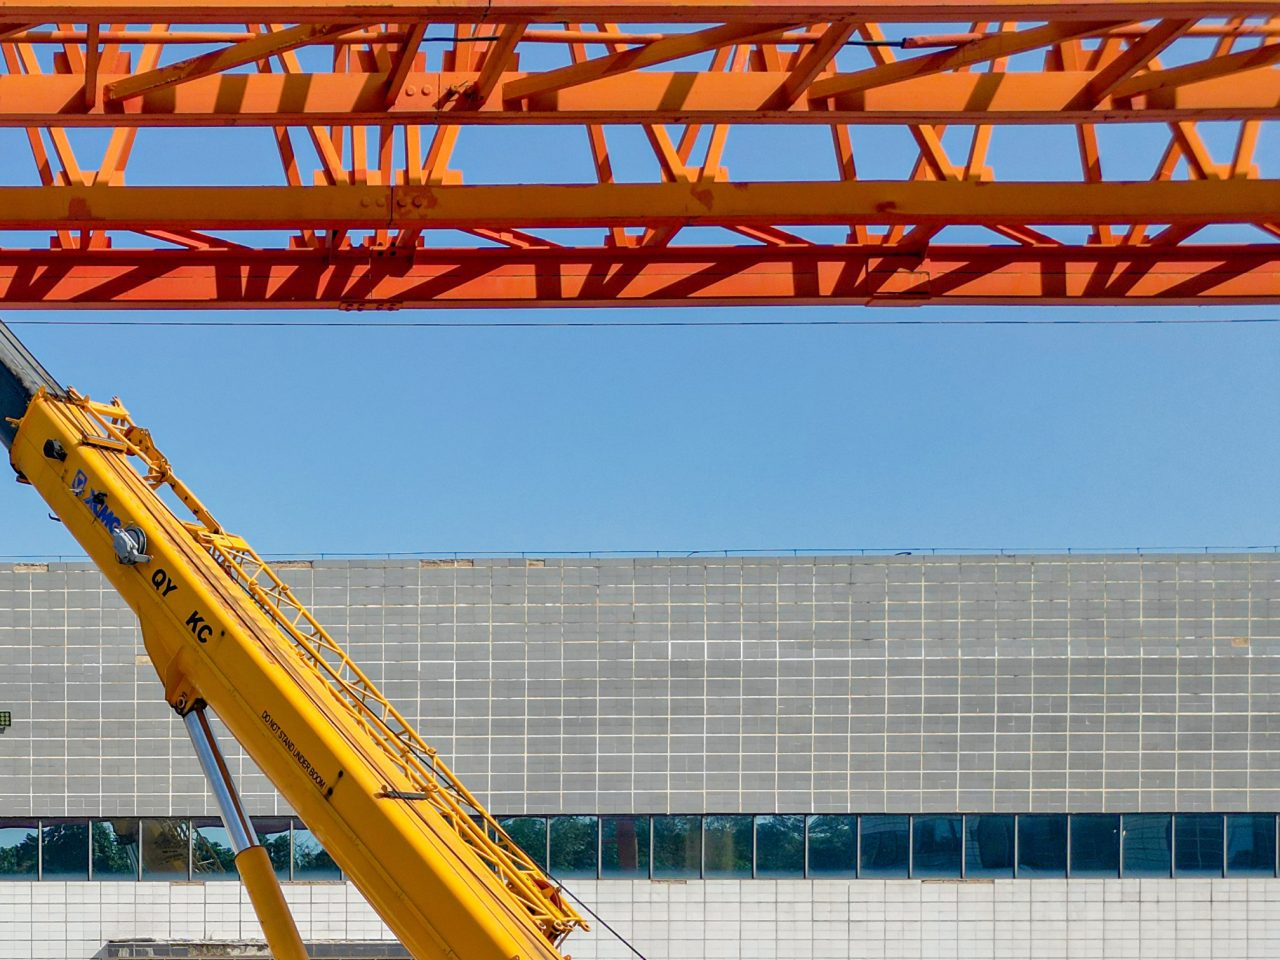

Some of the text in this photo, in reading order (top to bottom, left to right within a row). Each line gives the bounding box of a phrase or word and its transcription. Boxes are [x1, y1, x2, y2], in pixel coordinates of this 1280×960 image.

[151, 568, 178, 597] QY
[186, 610, 214, 643] KC
[268, 719, 280, 734] NOT
[278, 731, 295, 753] STAND
[293, 748, 312, 772] UNDER
[308, 767, 326, 790] BOOM
